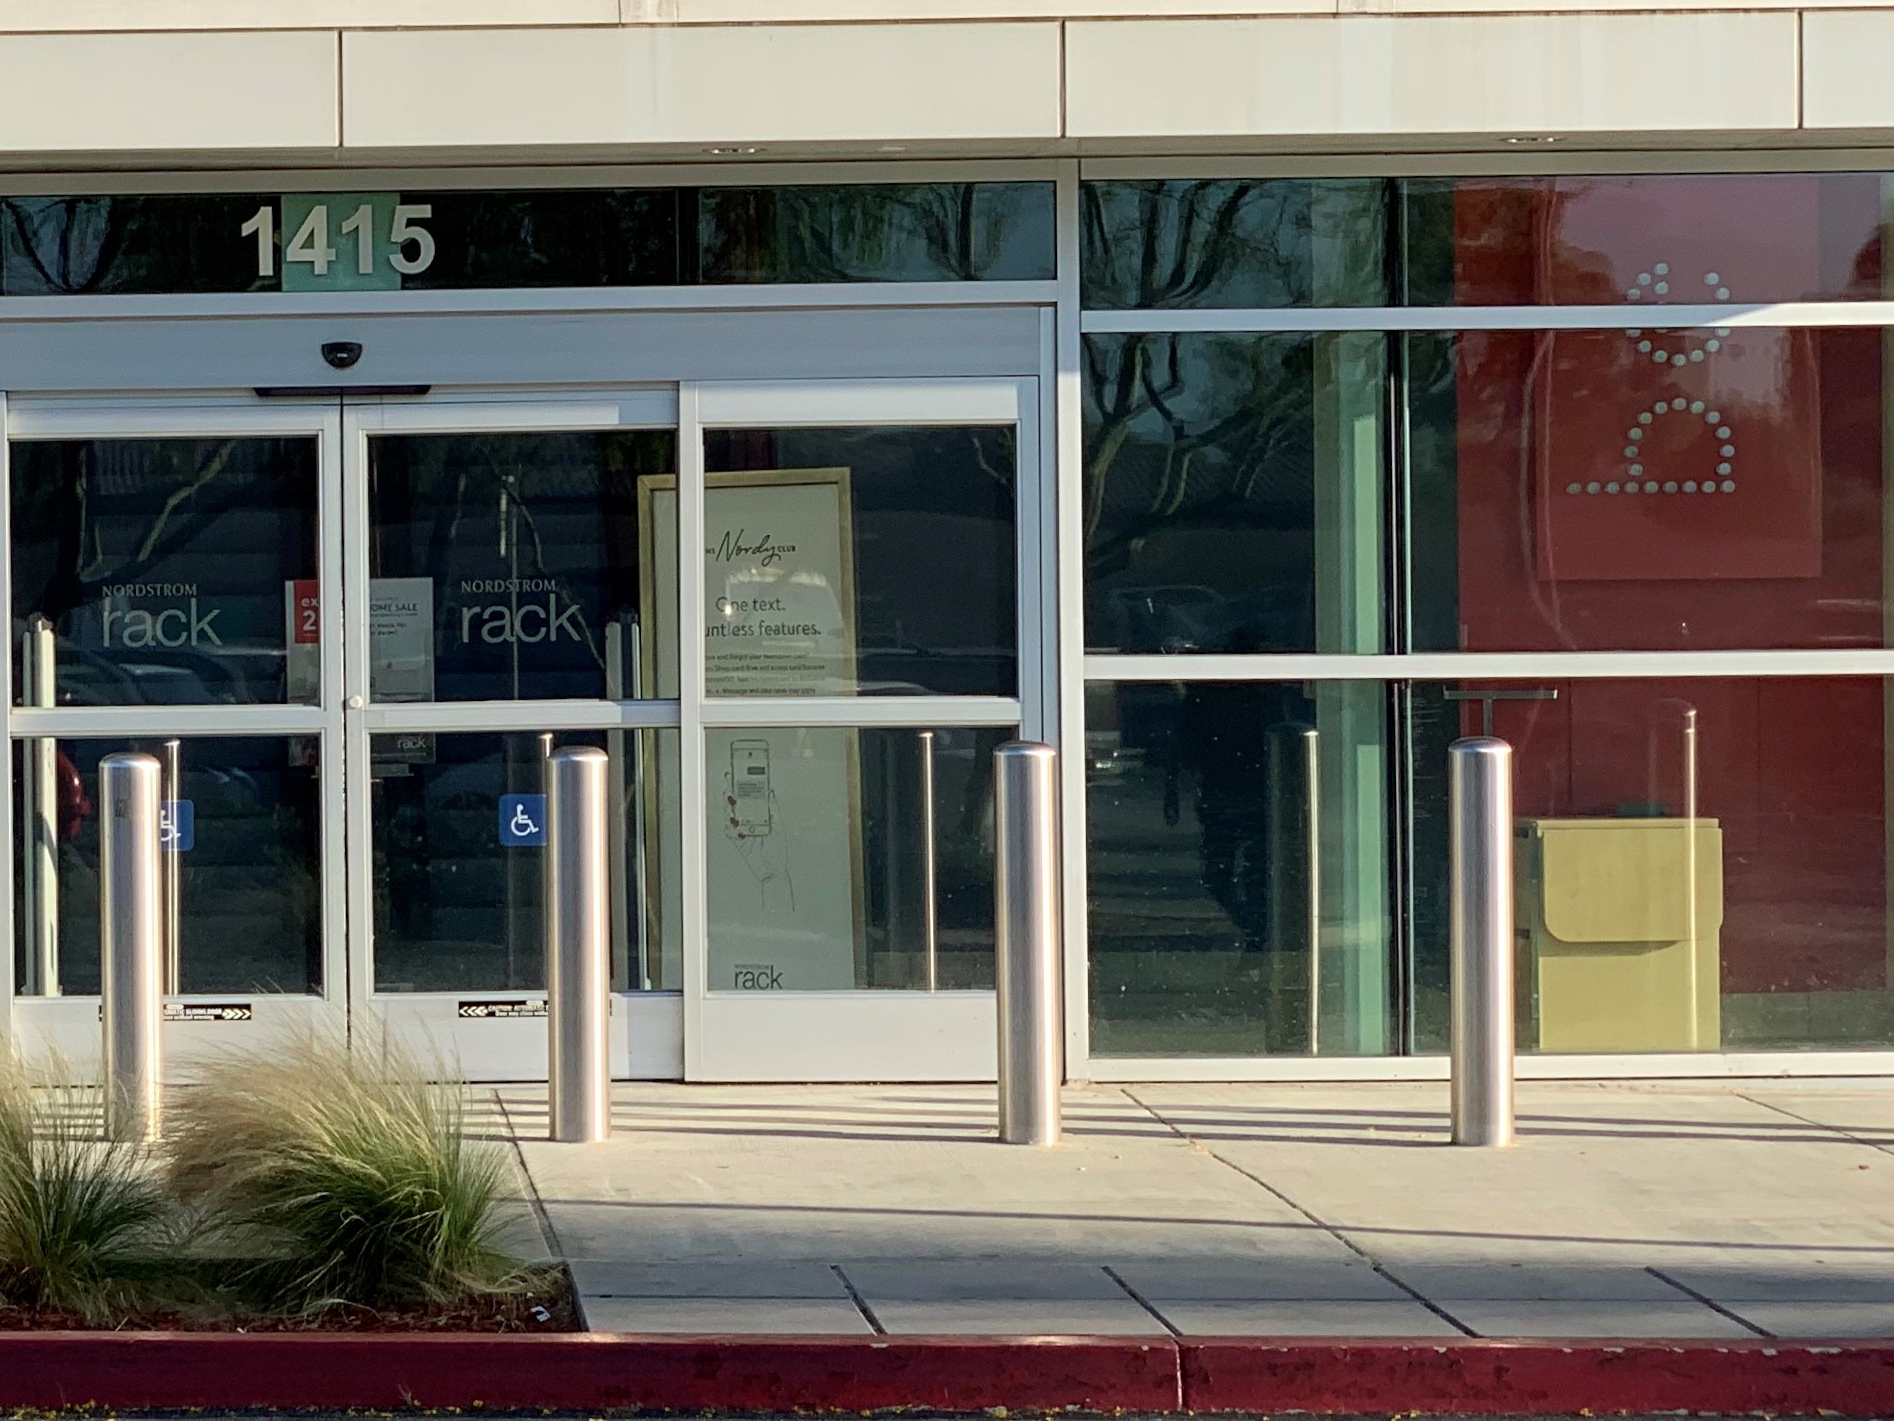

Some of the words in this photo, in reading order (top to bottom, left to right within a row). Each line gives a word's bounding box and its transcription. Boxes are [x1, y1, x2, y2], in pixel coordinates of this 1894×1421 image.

[240, 203, 436, 277] 1415
[1566, 261, 1736, 495] be
[716, 528, 781, 567] Nordy
[777, 545, 796, 553] CLUB
[101, 583, 198, 598] NORDSTROM
[461, 579, 557, 593] NORDSTROM
[395, 602, 418, 612] SALE
[715, 596, 749, 612] One
[752, 597, 786, 611] text.
[101, 599, 222, 648] rack
[461, 594, 582, 644] rack
[758, 620, 822, 636] features.
[396, 736, 427, 749] rack
[734, 964, 784, 990] rack
